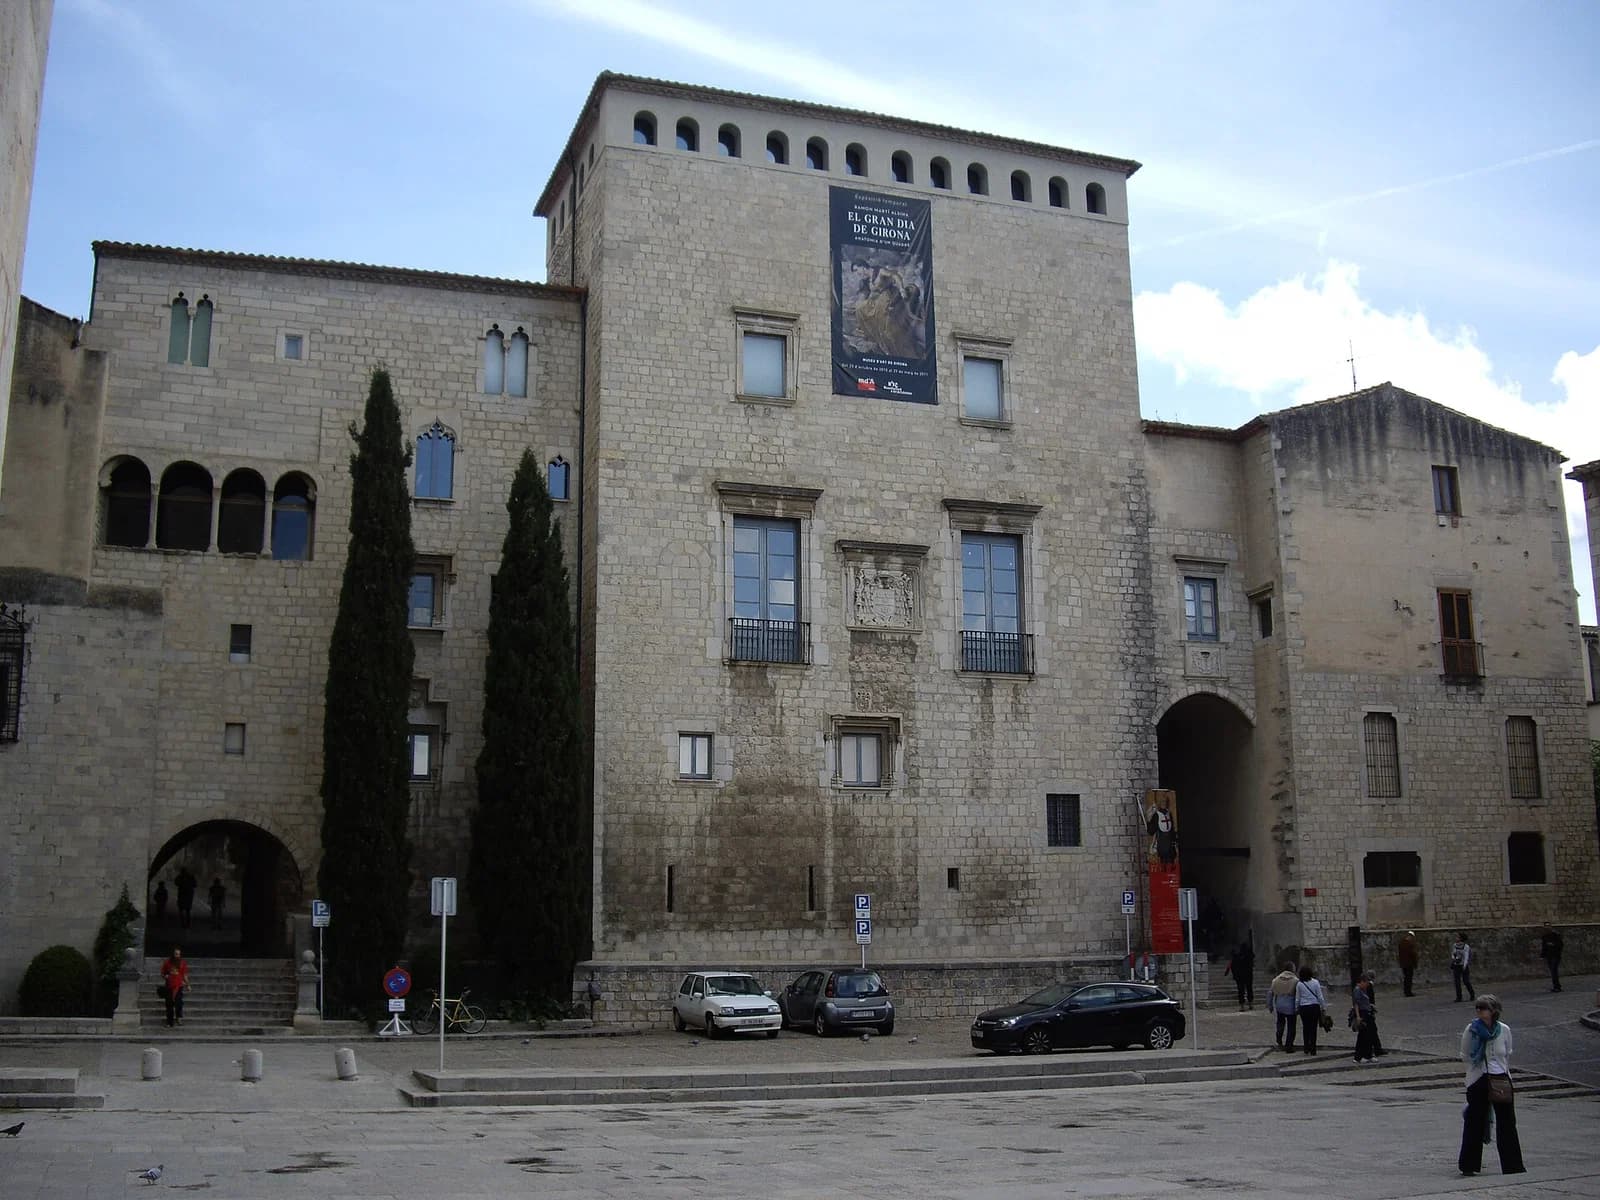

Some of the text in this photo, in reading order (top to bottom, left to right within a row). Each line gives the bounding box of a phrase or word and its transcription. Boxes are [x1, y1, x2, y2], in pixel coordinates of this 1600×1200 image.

[848, 211, 915, 231] EL GRAN DIA
[853, 223, 911, 241] DE GIRONA
[858, 897, 866, 908] P
[1124, 893, 1132, 904] P
[317, 903, 326, 915] P
[859, 922, 867, 934] P
